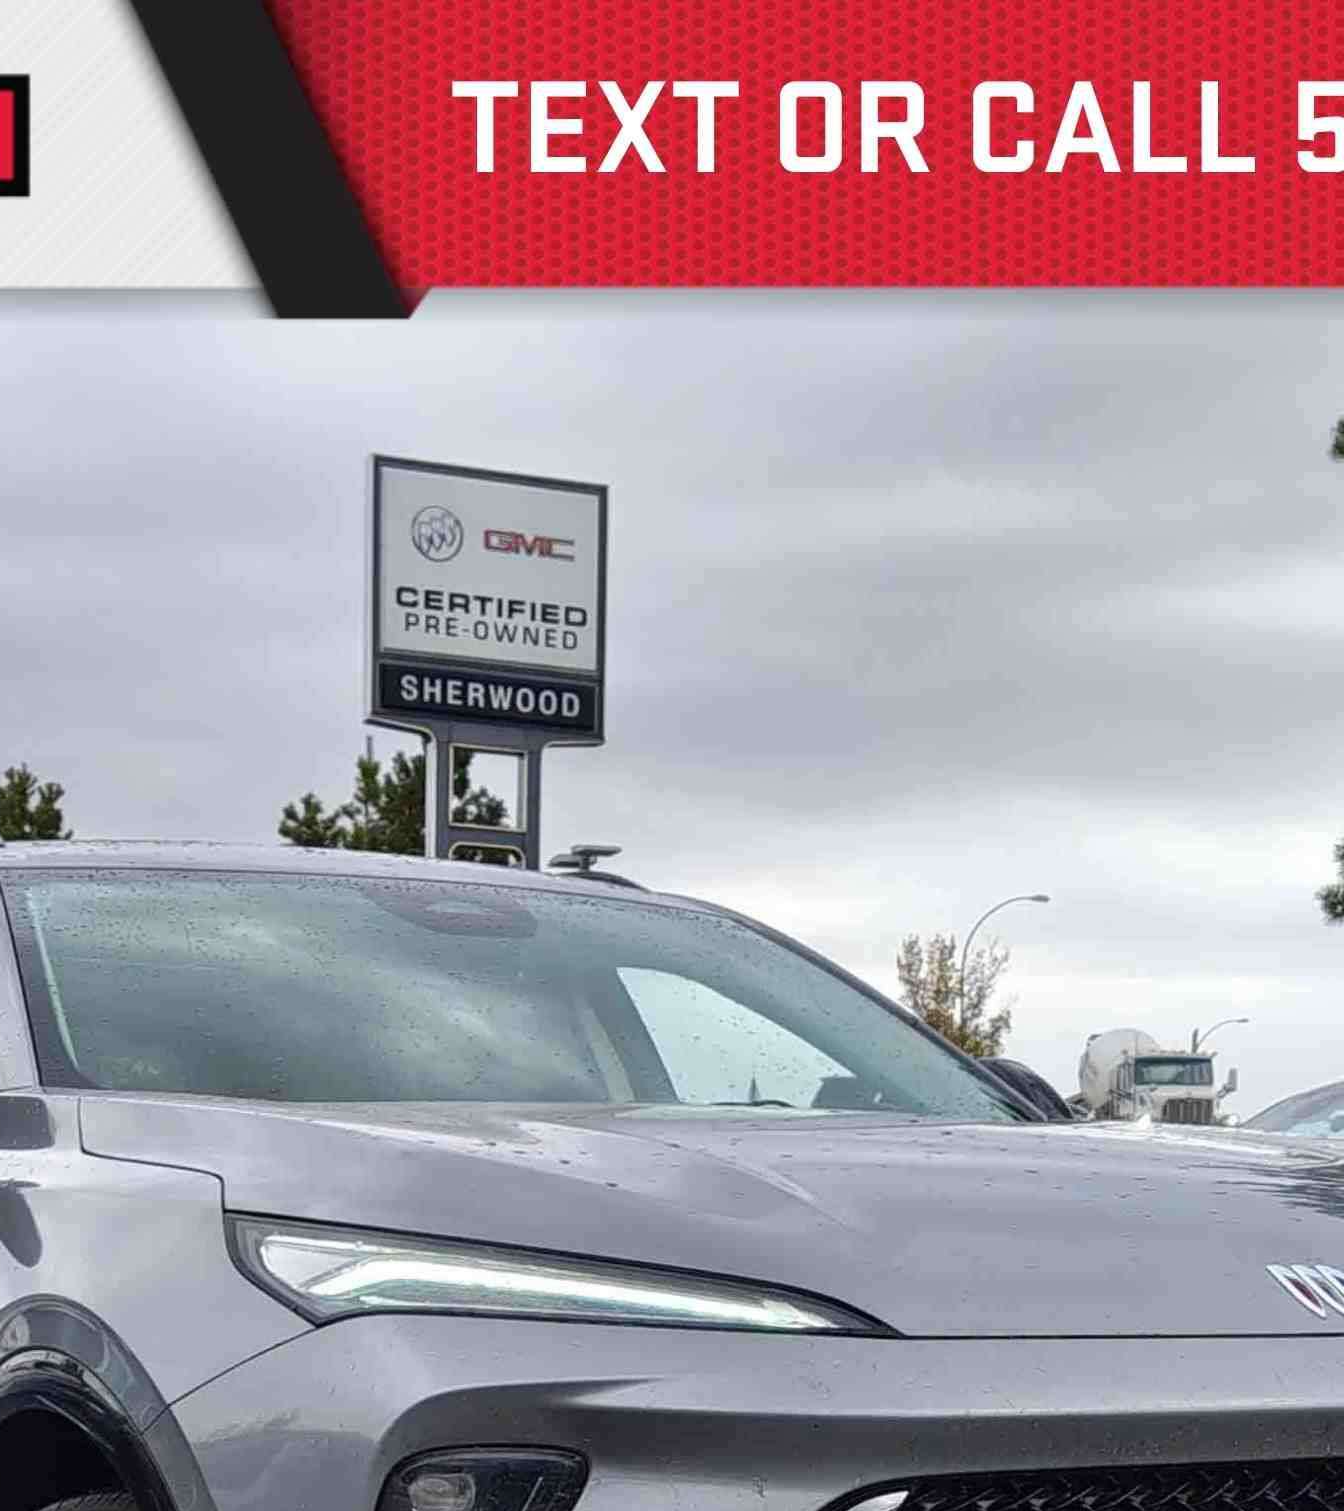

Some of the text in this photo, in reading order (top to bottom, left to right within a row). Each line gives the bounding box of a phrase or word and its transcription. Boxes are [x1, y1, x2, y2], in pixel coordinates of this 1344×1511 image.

[483, 529, 575, 562] GMC
[395, 586, 588, 627] CERTIFIED
[403, 613, 579, 650] PRE-OWNED
[400, 674, 580, 718] SHERWOOD
